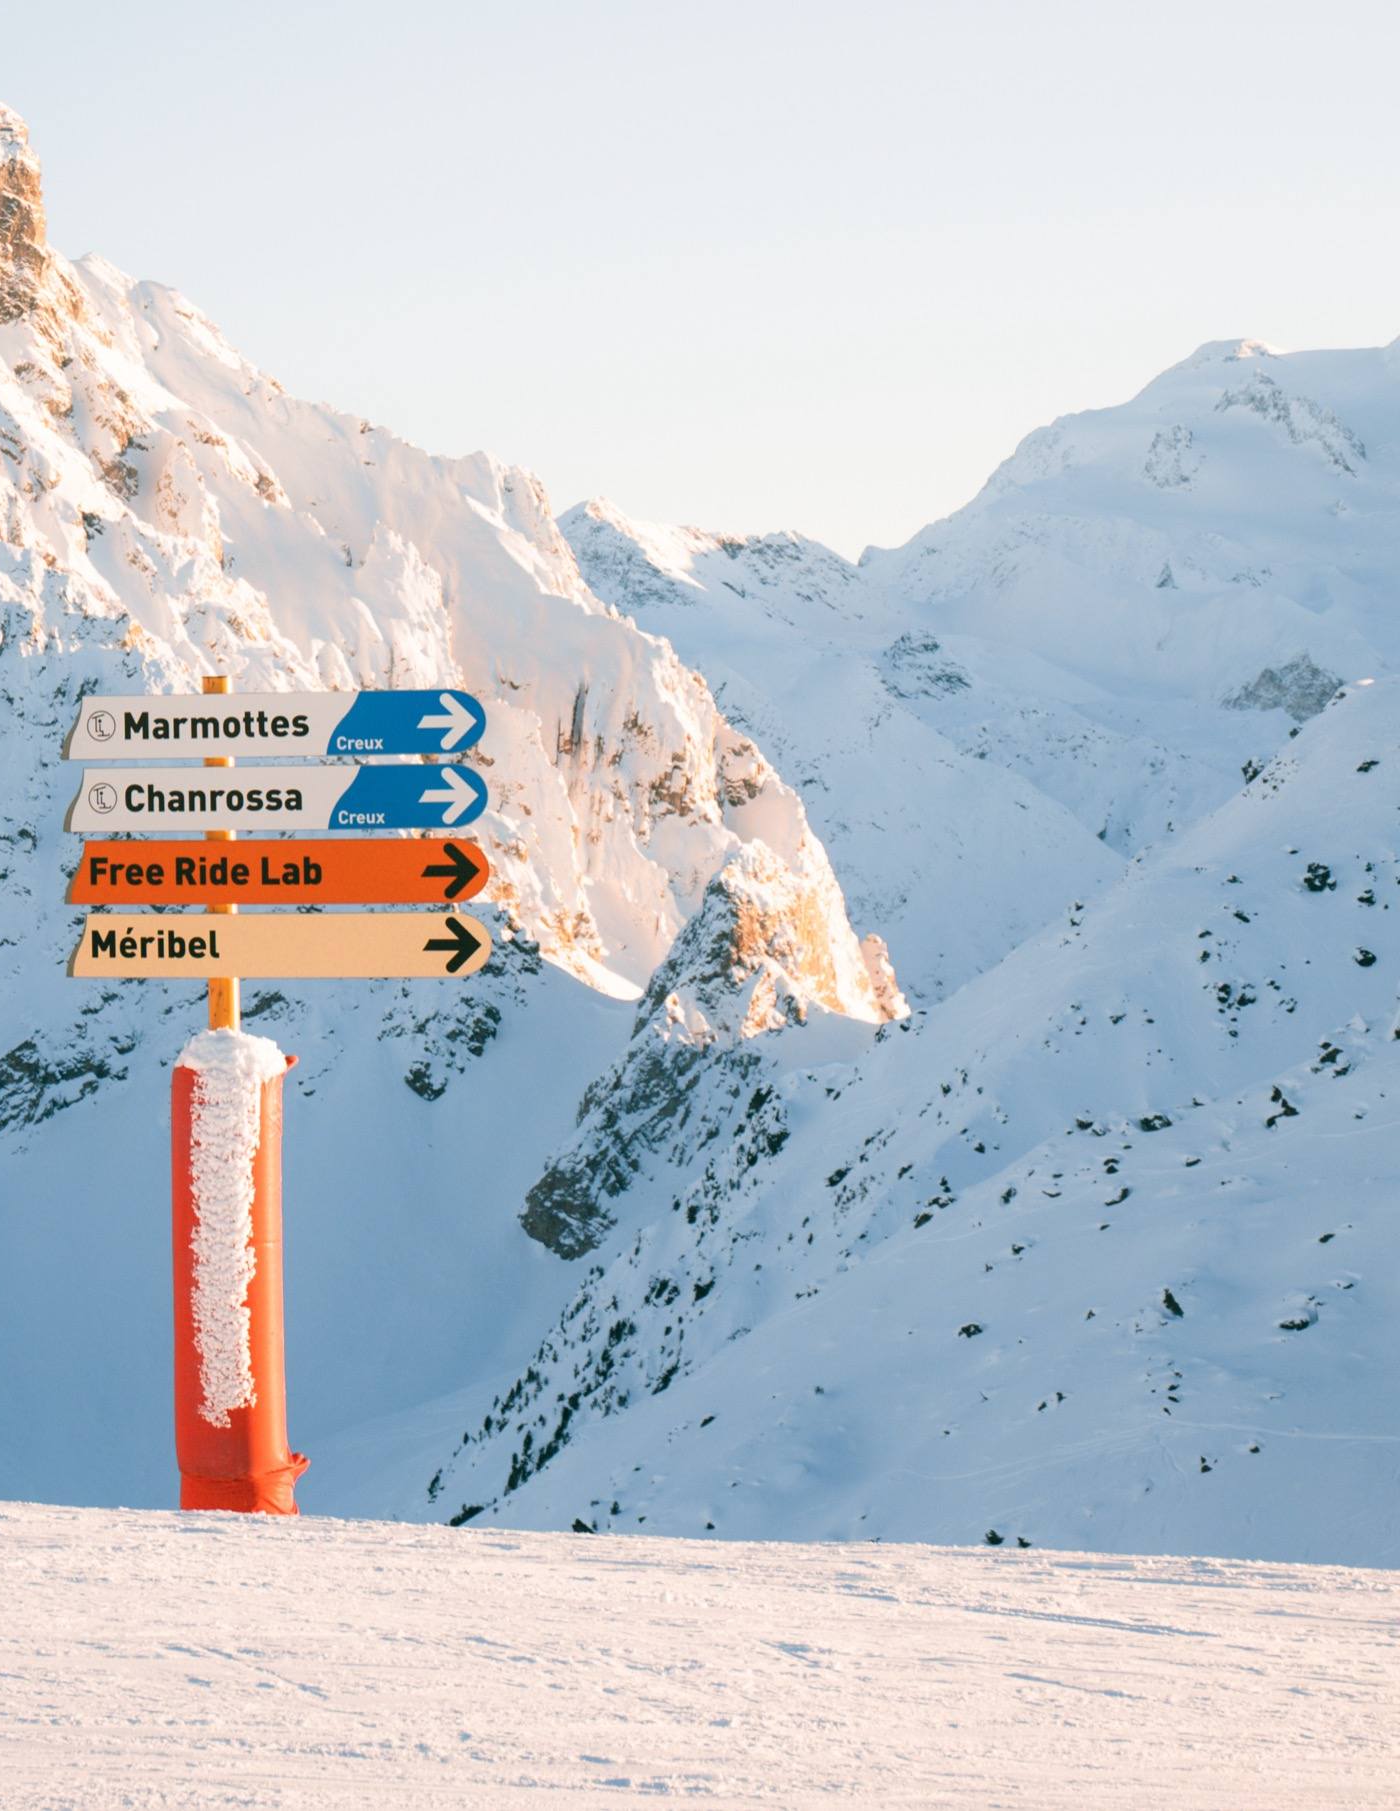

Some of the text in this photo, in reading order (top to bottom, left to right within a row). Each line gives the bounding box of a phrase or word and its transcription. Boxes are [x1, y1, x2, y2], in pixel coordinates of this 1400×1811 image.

[123, 710, 310, 740] Marmottes
[336, 736, 384, 751] Creux
[124, 784, 303, 812] Chanrossa
[338, 810, 385, 825] Creux
[90, 856, 322, 886] Free Ride Lab
[91, 927, 220, 959] Méribel
